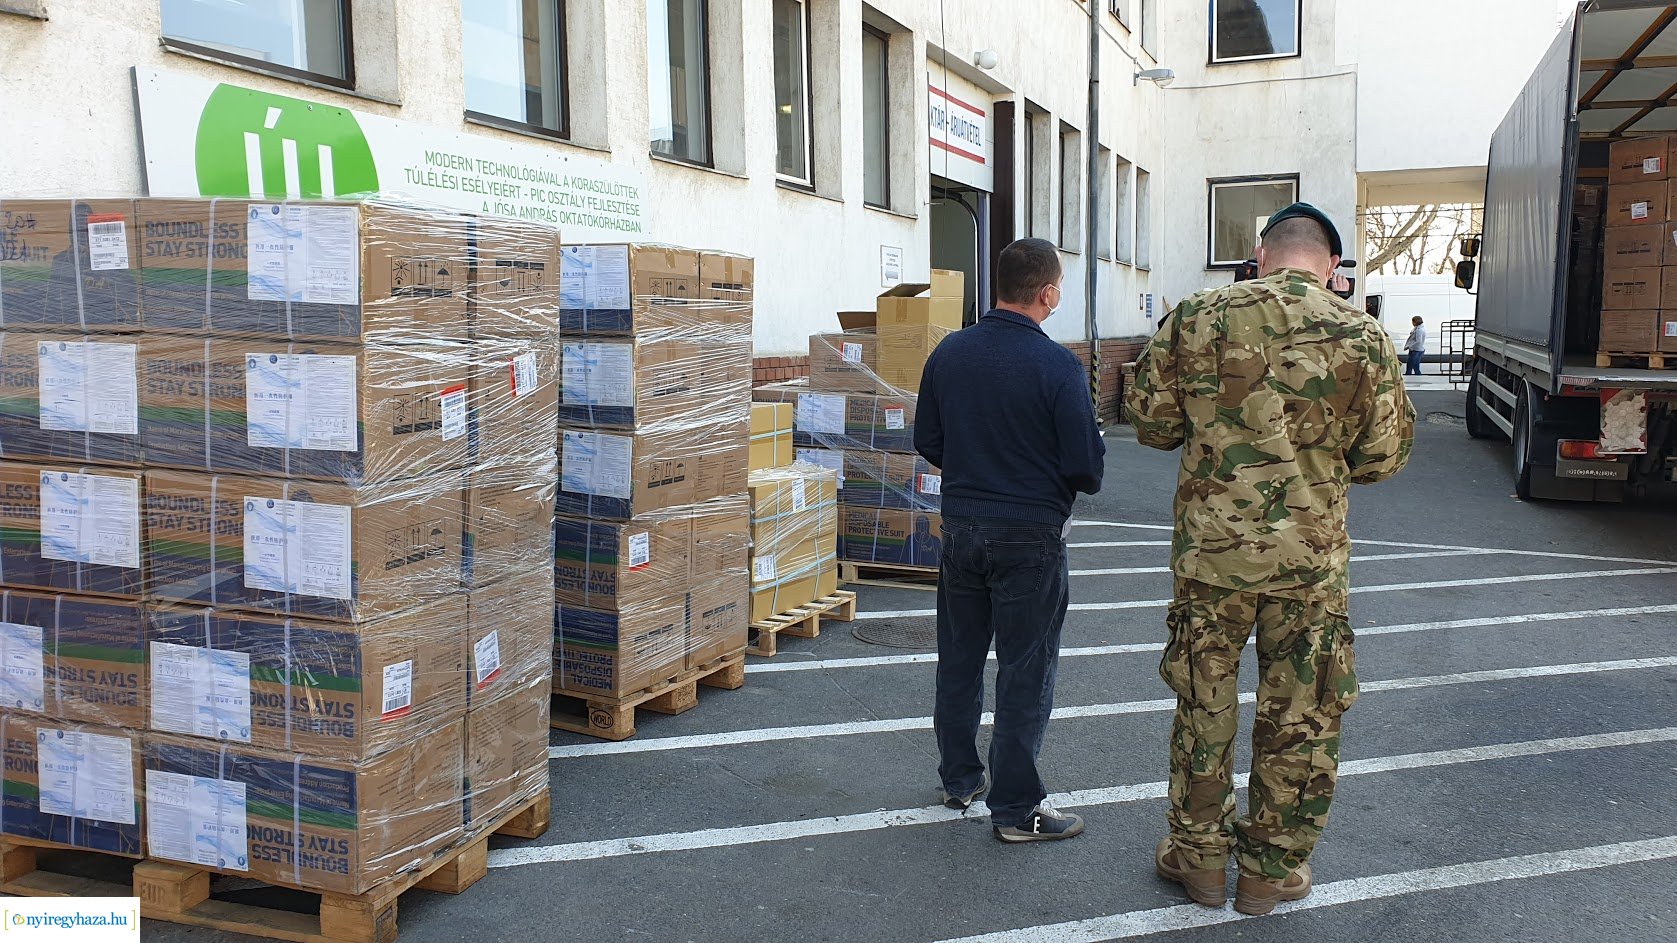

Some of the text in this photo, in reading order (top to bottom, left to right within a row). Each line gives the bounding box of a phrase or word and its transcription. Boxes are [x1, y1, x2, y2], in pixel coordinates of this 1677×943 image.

[425, 150, 640, 200] MODERN TECHNOLÓGIÁVAL A KORASZÜLÖTTEK
[404, 165, 459, 191] TÚLÉLÉSI
[461, 175, 521, 199] ESÉLYEIÉRT
[530, 188, 546, 203] PIC
[548, 190, 585, 208] OSZTÁLY
[587, 196, 641, 217] FEJLESZTÉSE
[145, 221, 240, 240] BOUNDLESS
[559, 211, 642, 234] OKTATÓKÓRHÁZBAN
[145, 240, 182, 256] STAY
[148, 512, 185, 531] STAY
[848, 526, 905, 538] PROTECIVE SUIT
[554, 566, 615, 583] STAY STRON
[98, 671, 138, 689] STAY
[571, 673, 613, 690] MEDICAL
[593, 714, 612, 726] WORLD
[308, 835, 349, 855] STAY
[251, 843, 349, 875] BOUNDLESS
